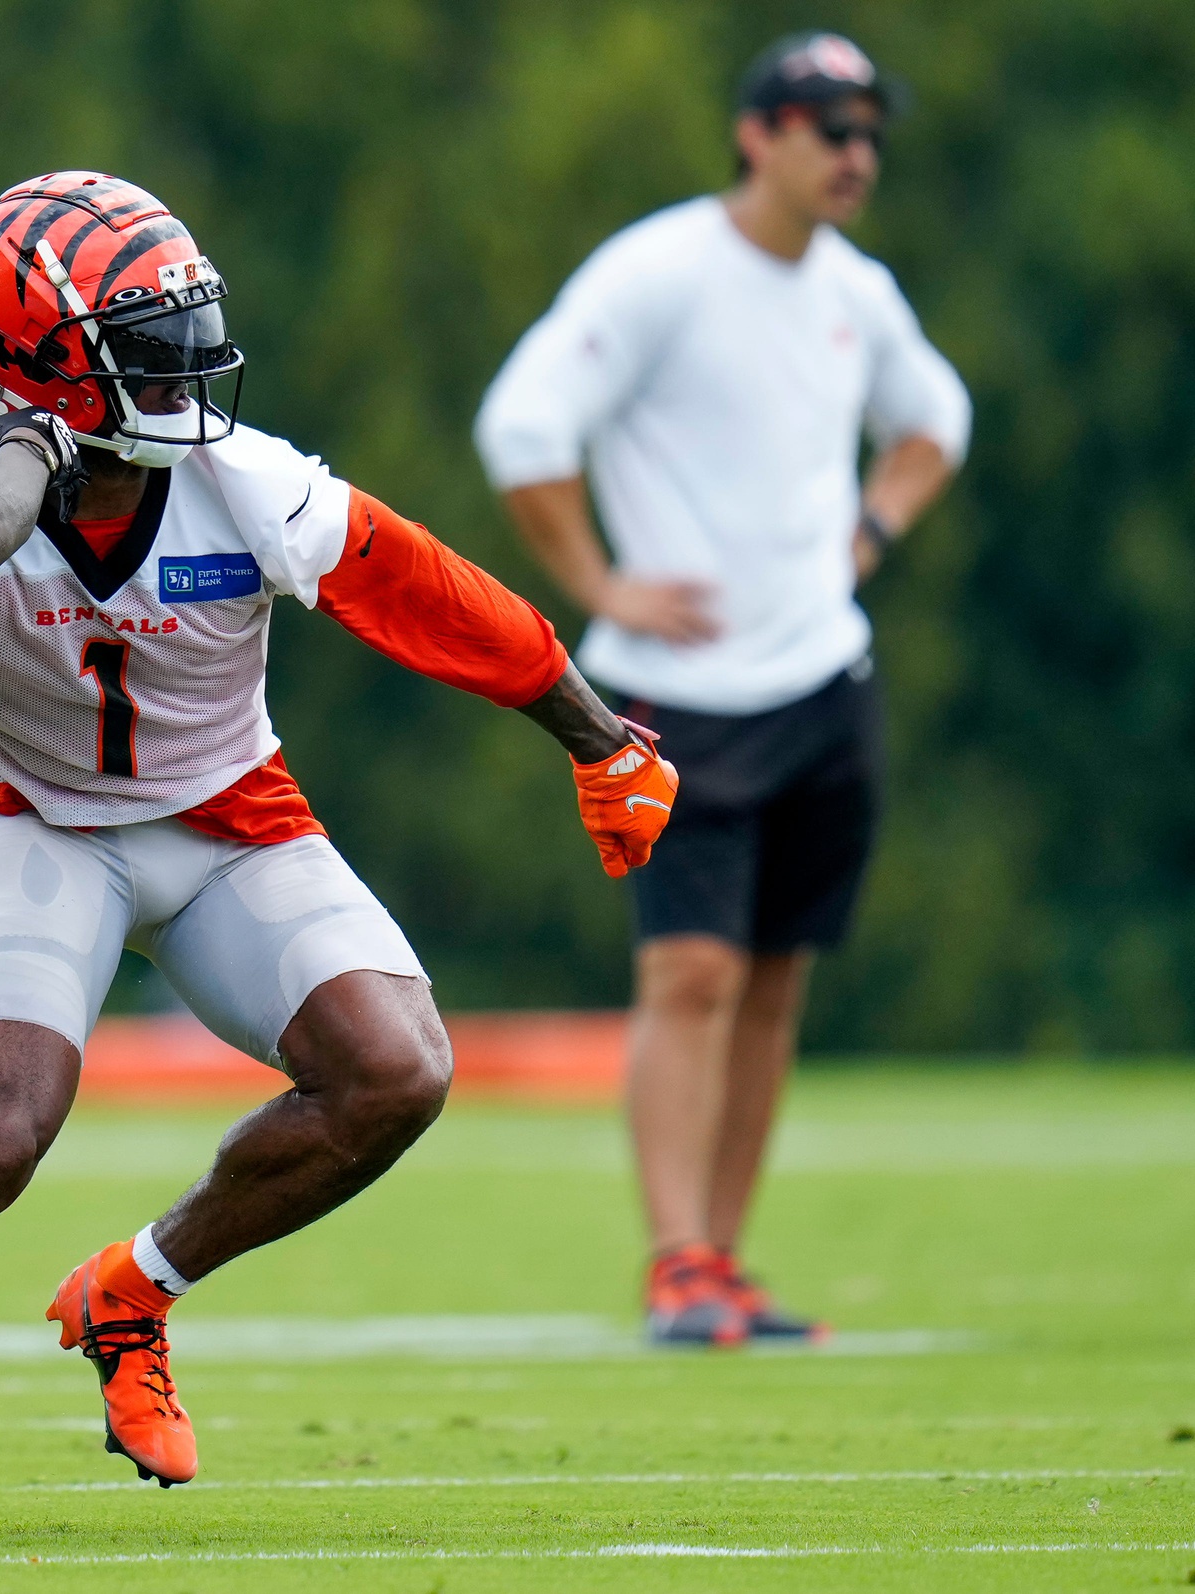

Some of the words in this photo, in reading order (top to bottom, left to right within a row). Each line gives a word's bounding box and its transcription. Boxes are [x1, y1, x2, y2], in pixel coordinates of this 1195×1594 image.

[198, 569, 222, 578] FIFTH
[224, 568, 254, 576] THIRD
[198, 578, 222, 587] BANK
[79, 637, 139, 778] 1
